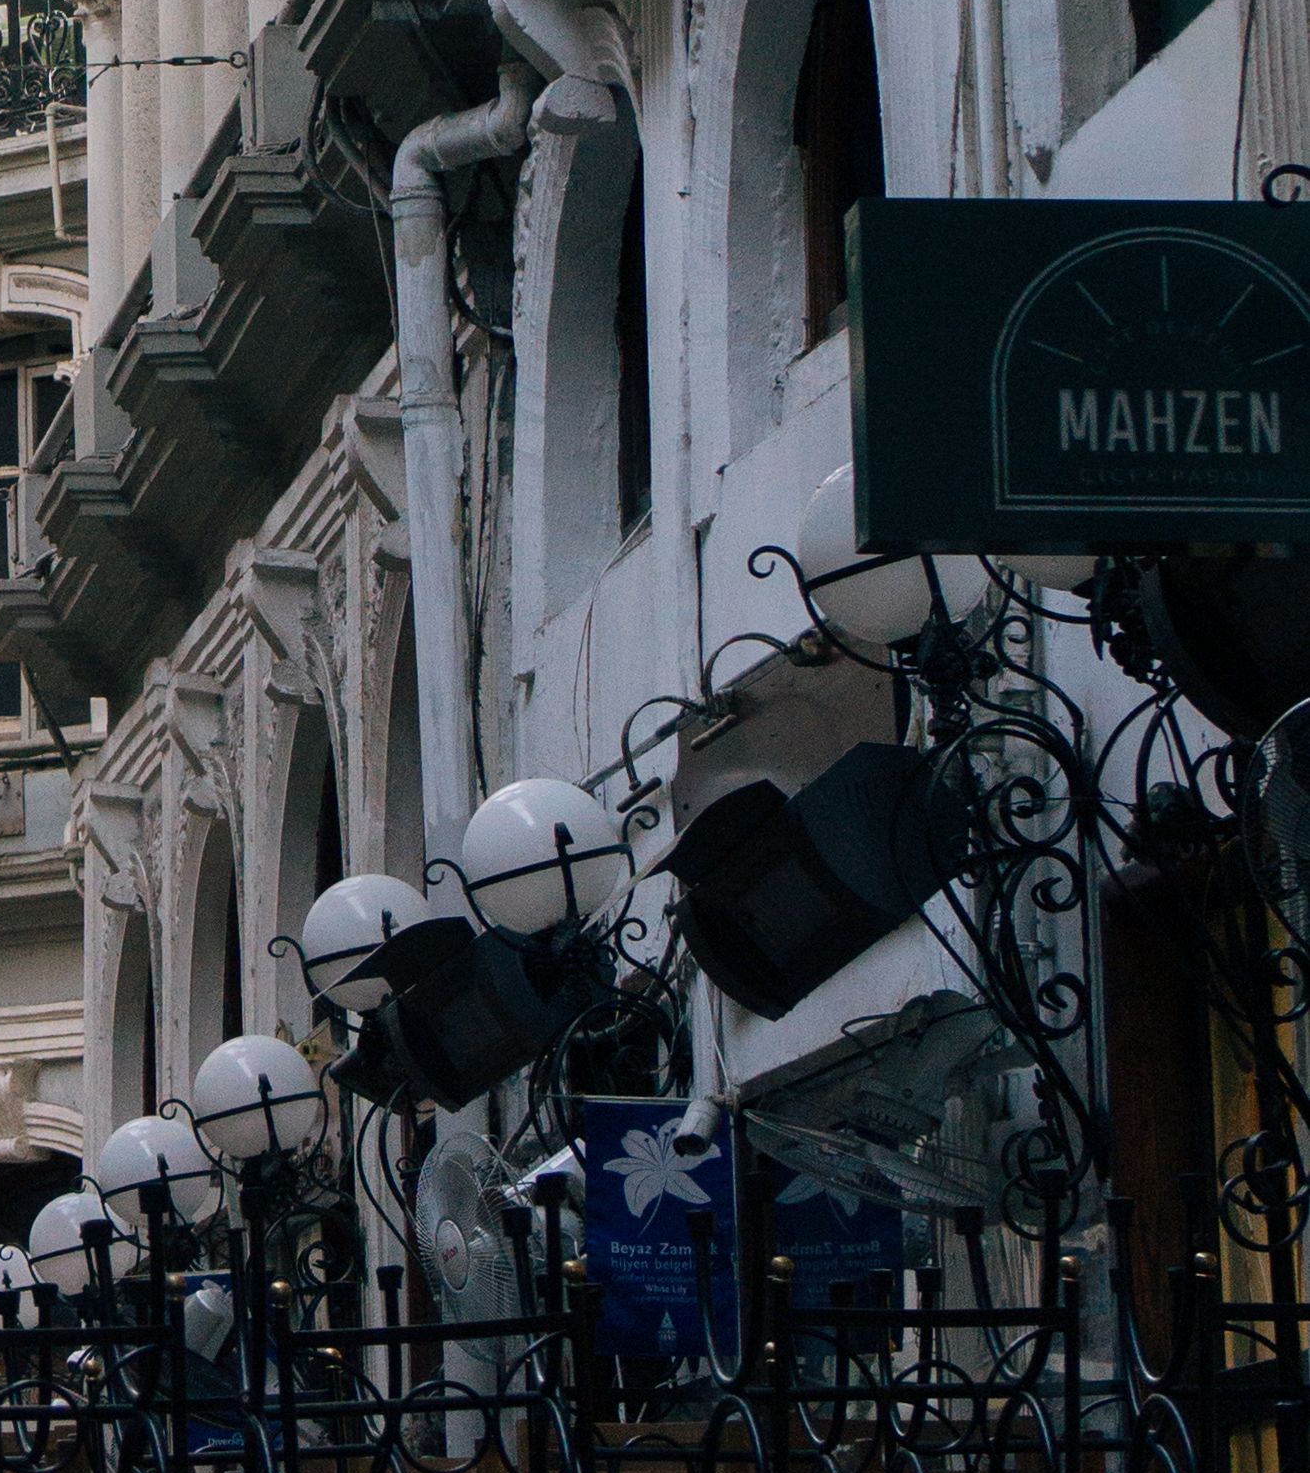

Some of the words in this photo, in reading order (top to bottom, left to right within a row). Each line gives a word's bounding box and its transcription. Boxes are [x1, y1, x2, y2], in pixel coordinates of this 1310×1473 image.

[1059, 387, 1280, 454] MAHZEN
[610, 1241, 652, 1257] Beyaz
[659, 1241, 719, 1256] Zamk
[610, 1257, 649, 1272] hijyen
[644, 1283, 670, 1293] White
[671, 1283, 687, 1295] Lily
